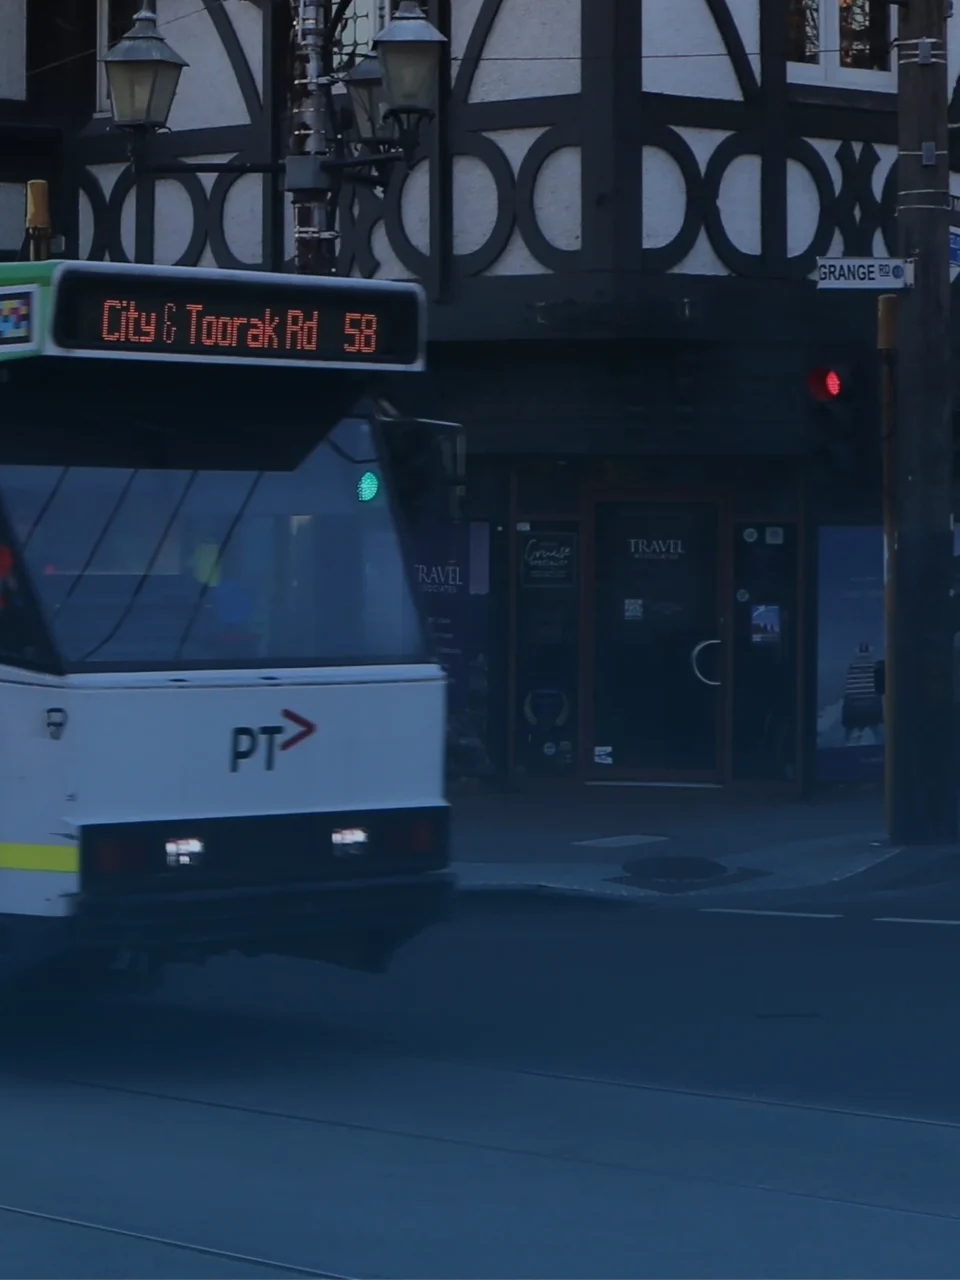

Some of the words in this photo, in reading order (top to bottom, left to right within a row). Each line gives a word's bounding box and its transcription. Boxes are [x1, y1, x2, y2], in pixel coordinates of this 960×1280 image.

[818, 264, 875, 280] GRANGE
[879, 264, 890, 275] RD
[101, 299, 157, 343] City
[163, 303, 177, 344] &
[186, 304, 280, 348] Toorak
[286, 309, 319, 351] Rd
[344, 312, 378, 353] 58
[626, 538, 687, 554] TRAVEL
